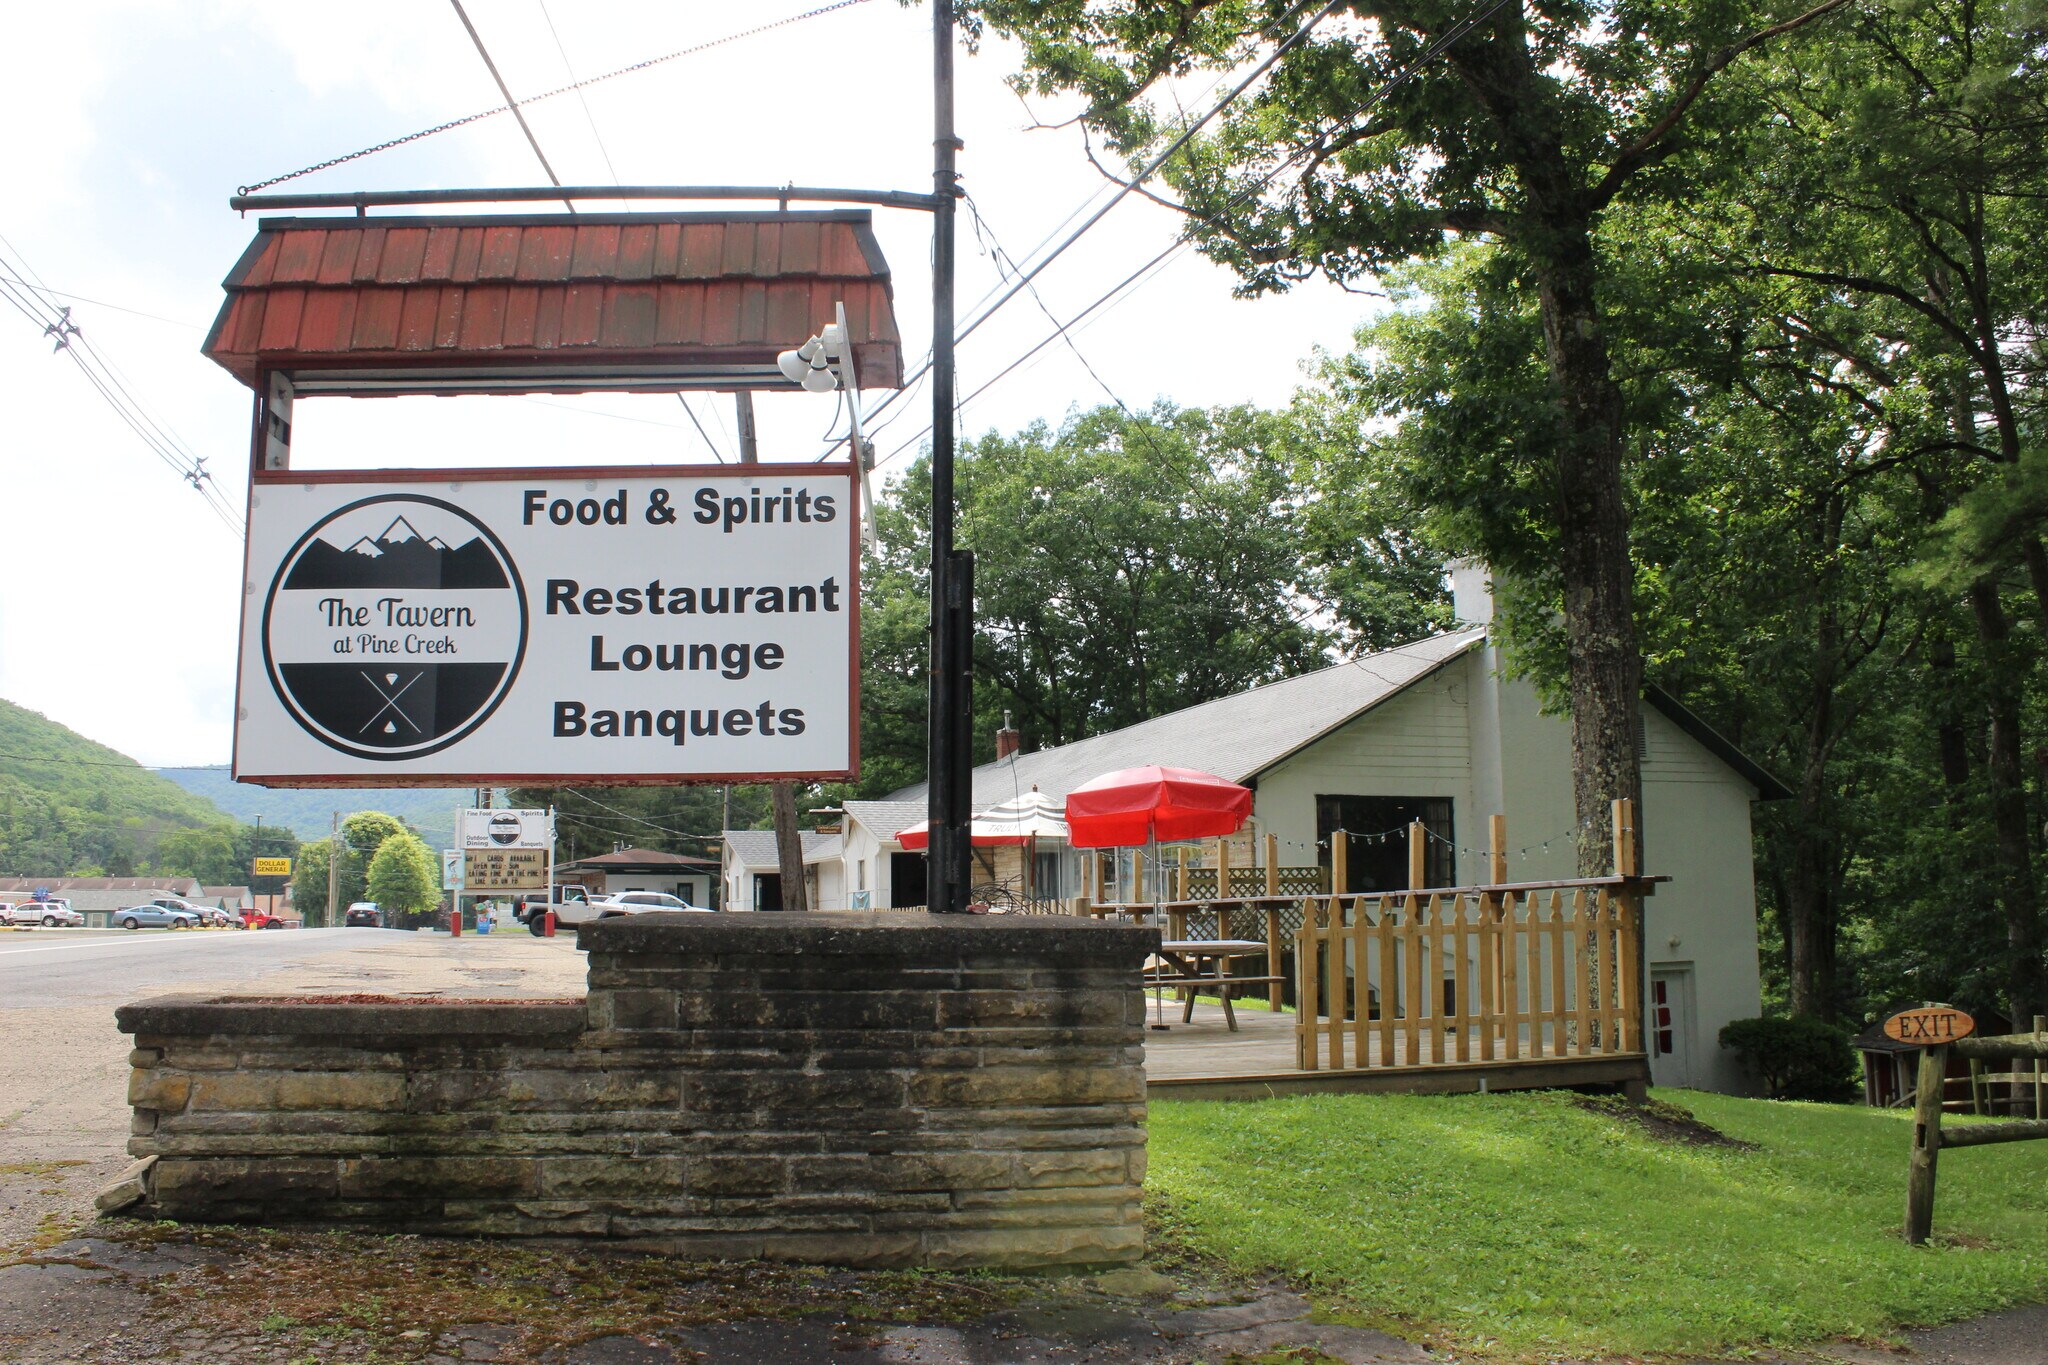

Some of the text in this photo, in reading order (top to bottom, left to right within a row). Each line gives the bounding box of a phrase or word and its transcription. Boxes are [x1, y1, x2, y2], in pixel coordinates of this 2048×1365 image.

[523, 487, 836, 534] Food & Spirits
[318, 597, 476, 628] The Tavern
[546, 576, 840, 616] Restaurant
[333, 633, 458, 654] at Pine Creek
[590, 635, 785, 681] Lounge
[553, 700, 806, 746] Banquets
[988, 824, 1017, 833] TRULY
[1898, 1013, 1957, 1038] EXIT
